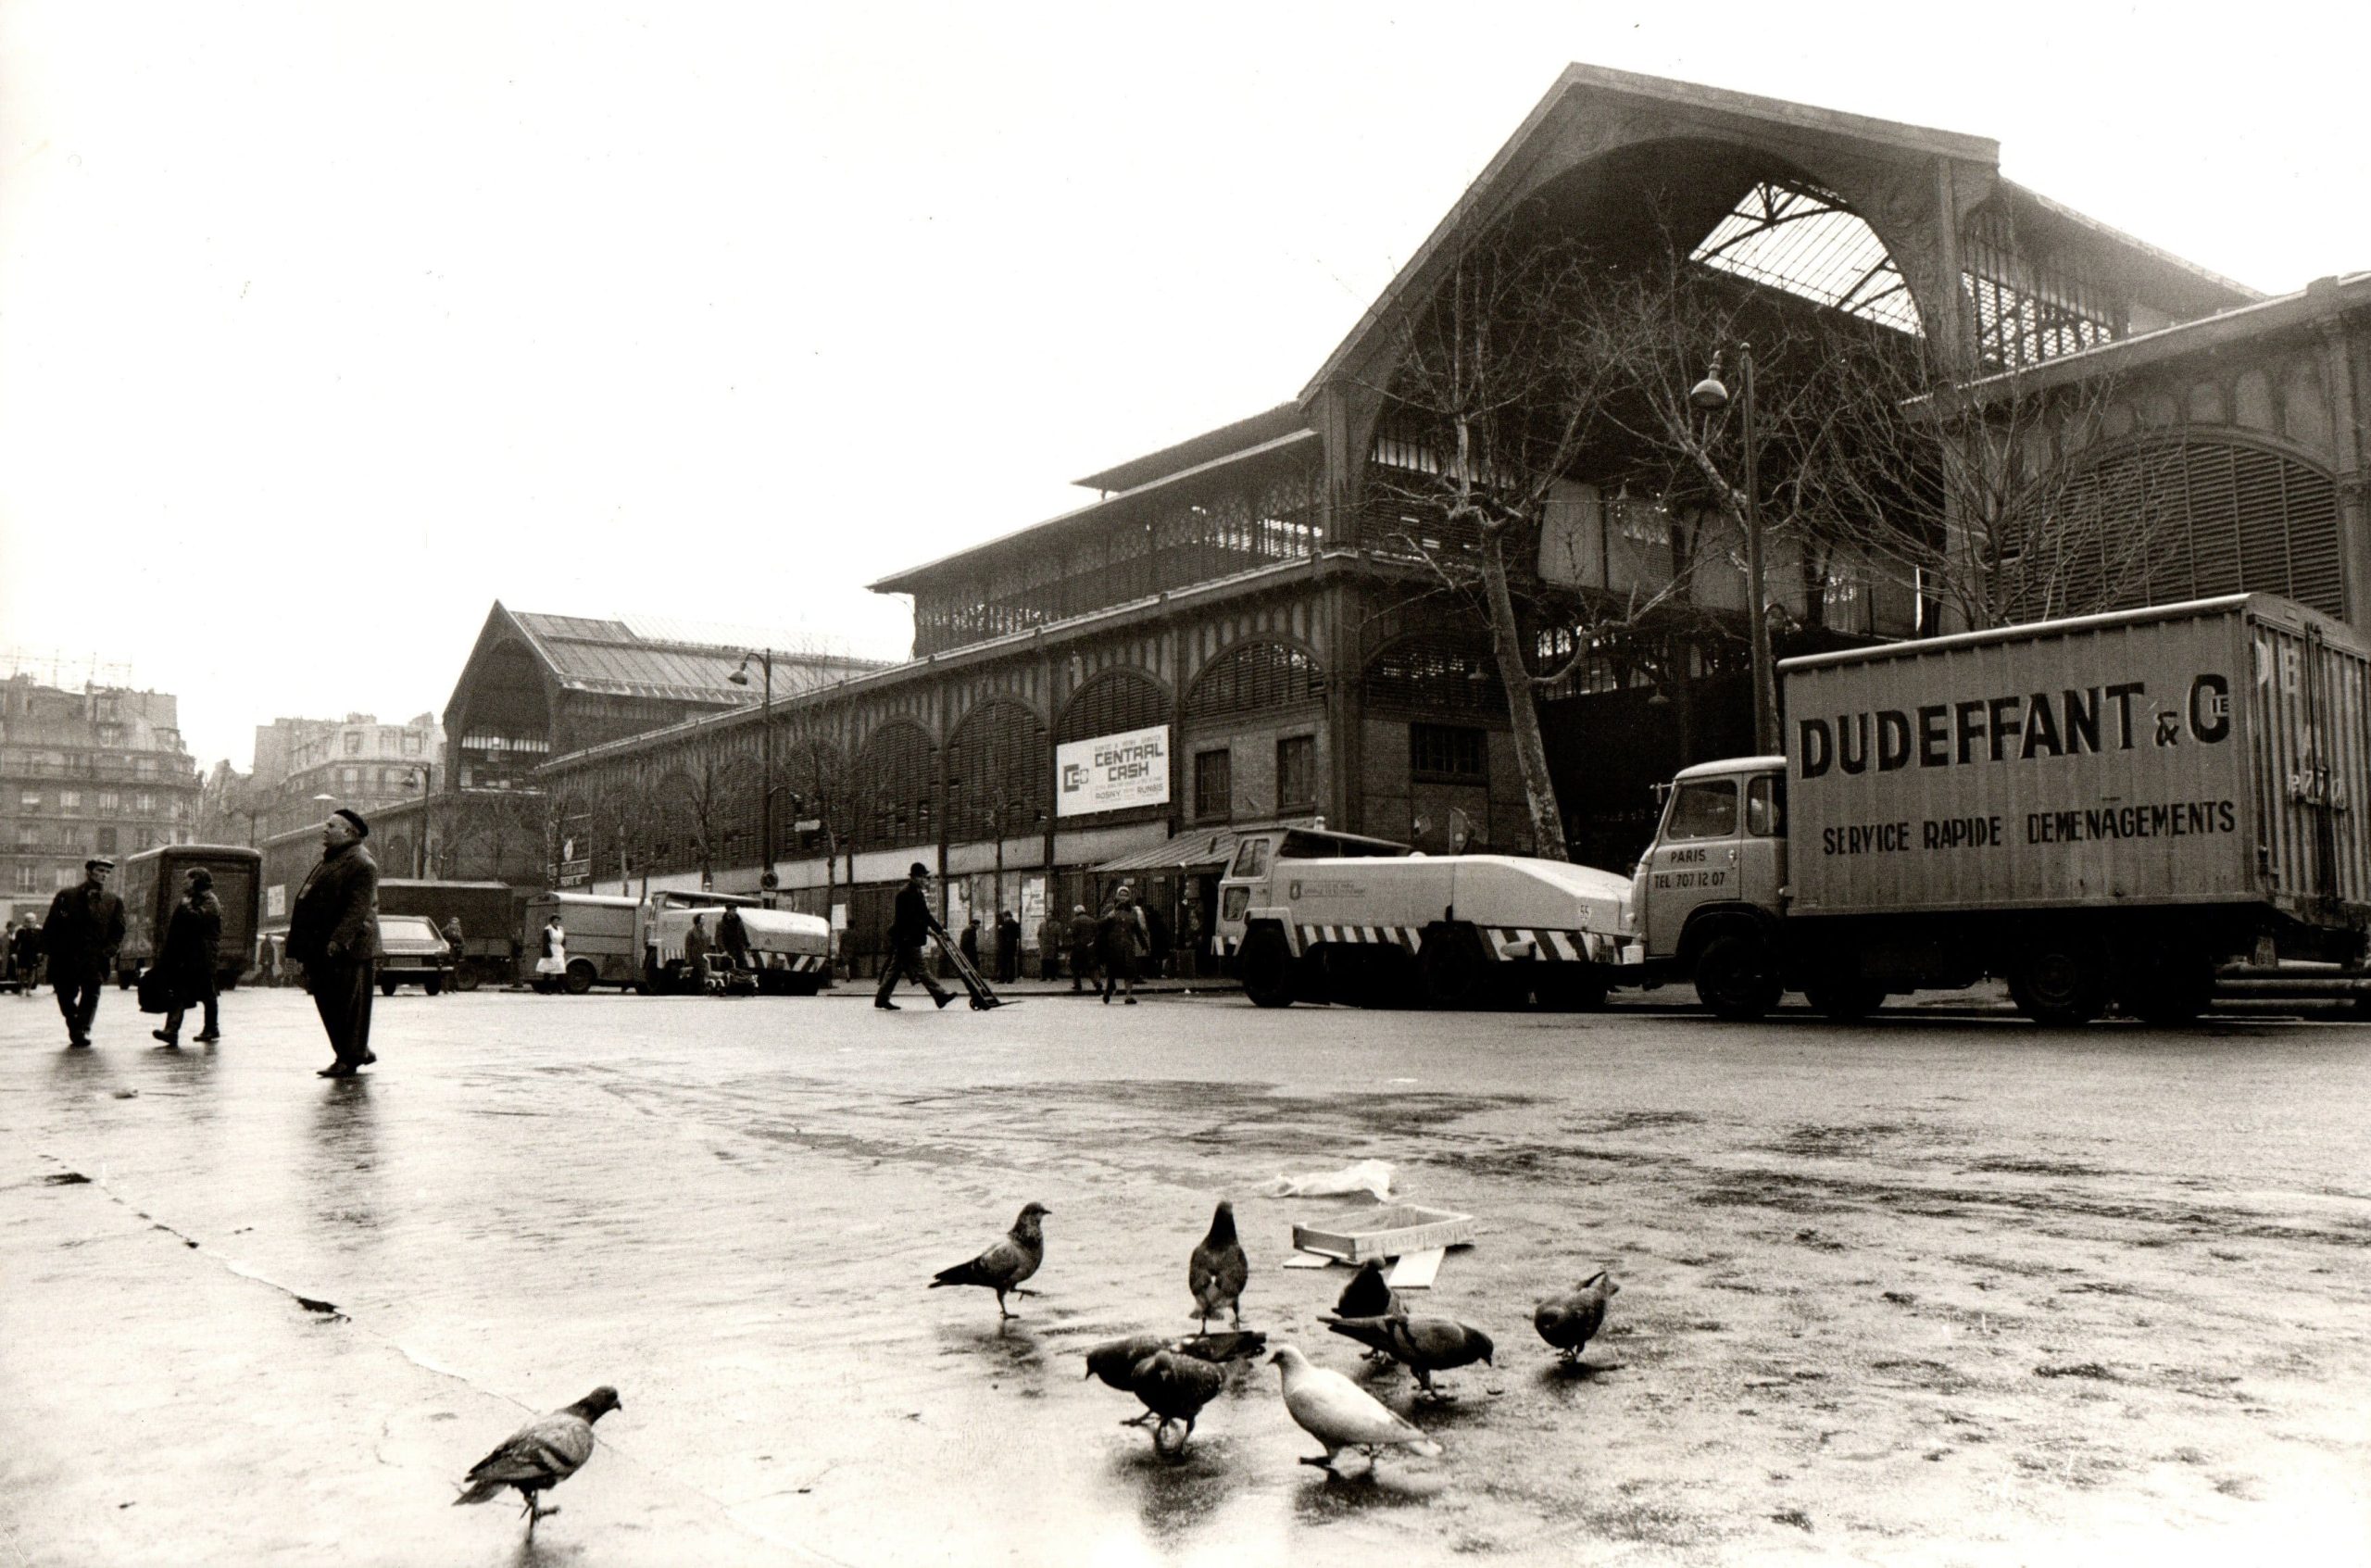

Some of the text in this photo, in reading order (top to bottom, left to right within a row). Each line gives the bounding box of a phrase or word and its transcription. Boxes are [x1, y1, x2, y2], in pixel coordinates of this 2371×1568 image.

[1799, 682, 2145, 780] DUDEFFANT
[2154, 711, 2179, 746] &
[1094, 742, 1164, 768] CENTRAL
[1107, 760, 1149, 782] CASH
[1822, 799, 2235, 856] SERVICE RAPIDE DEMENAGEMENTS
[24, 844, 83, 855] JURIDIQUE
[1670, 848, 1706, 863] PARIS
[1654, 872, 1726, 889] TEL 707 12 07
